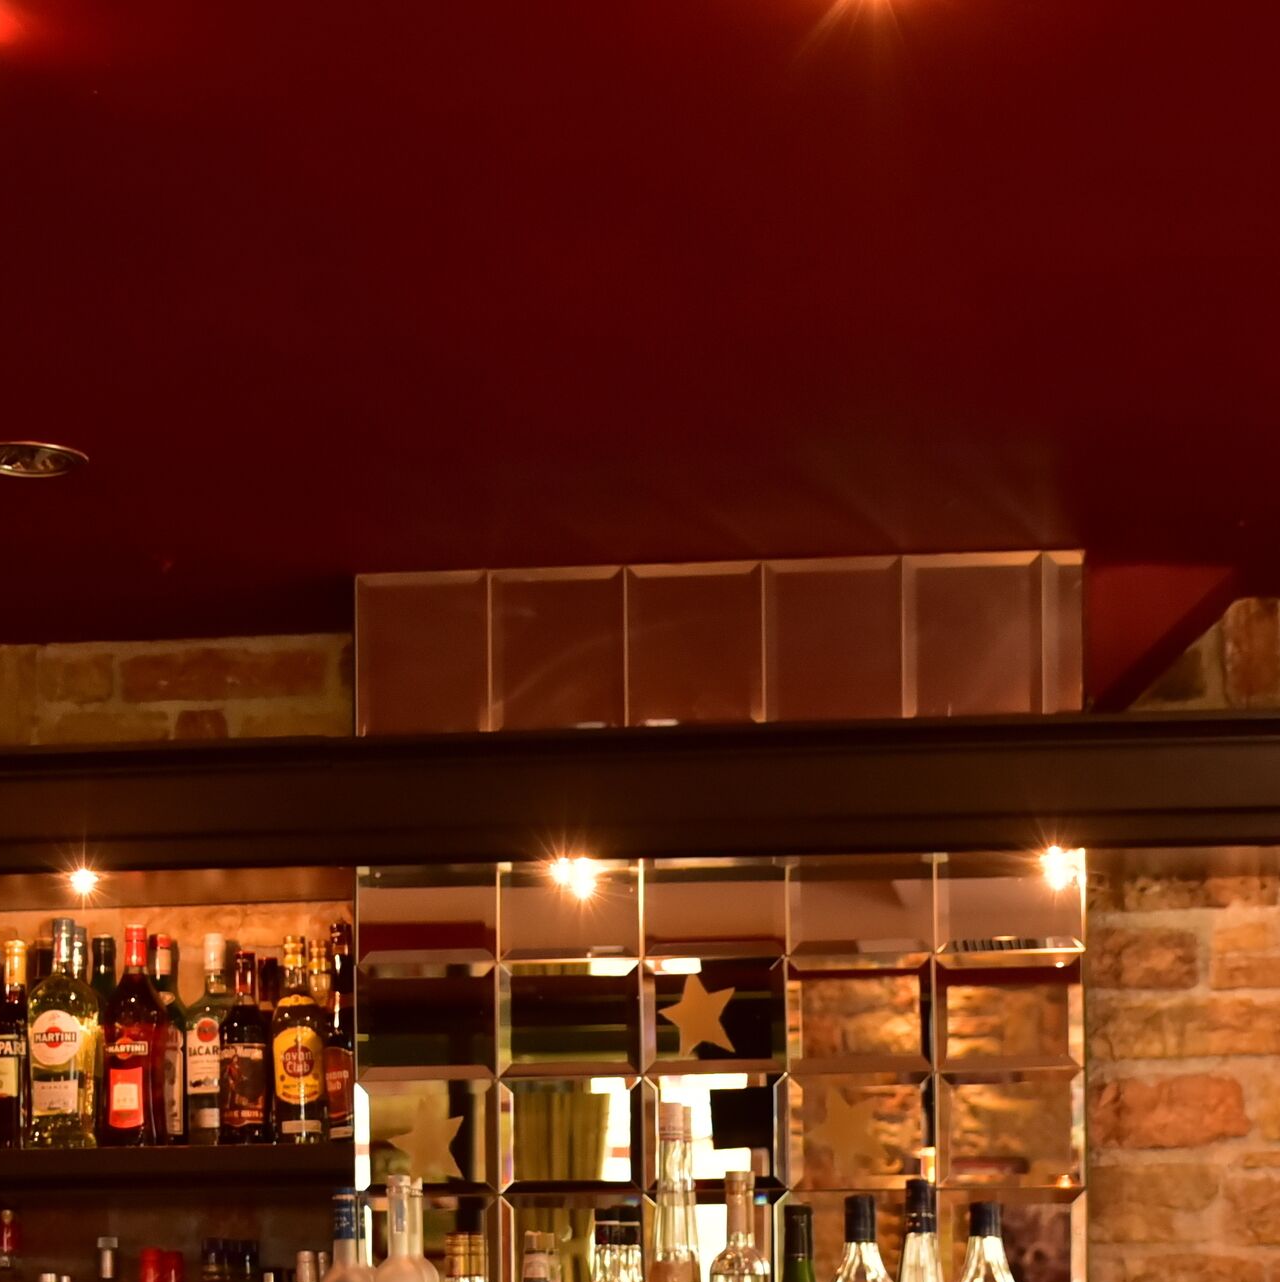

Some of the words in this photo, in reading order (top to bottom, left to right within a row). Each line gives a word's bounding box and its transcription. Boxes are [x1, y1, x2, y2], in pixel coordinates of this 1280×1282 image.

[34, 1032, 77, 1043] MARTINI
[108, 1043, 145, 1053] MARTINI
[189, 1045, 219, 1057] BACAR
